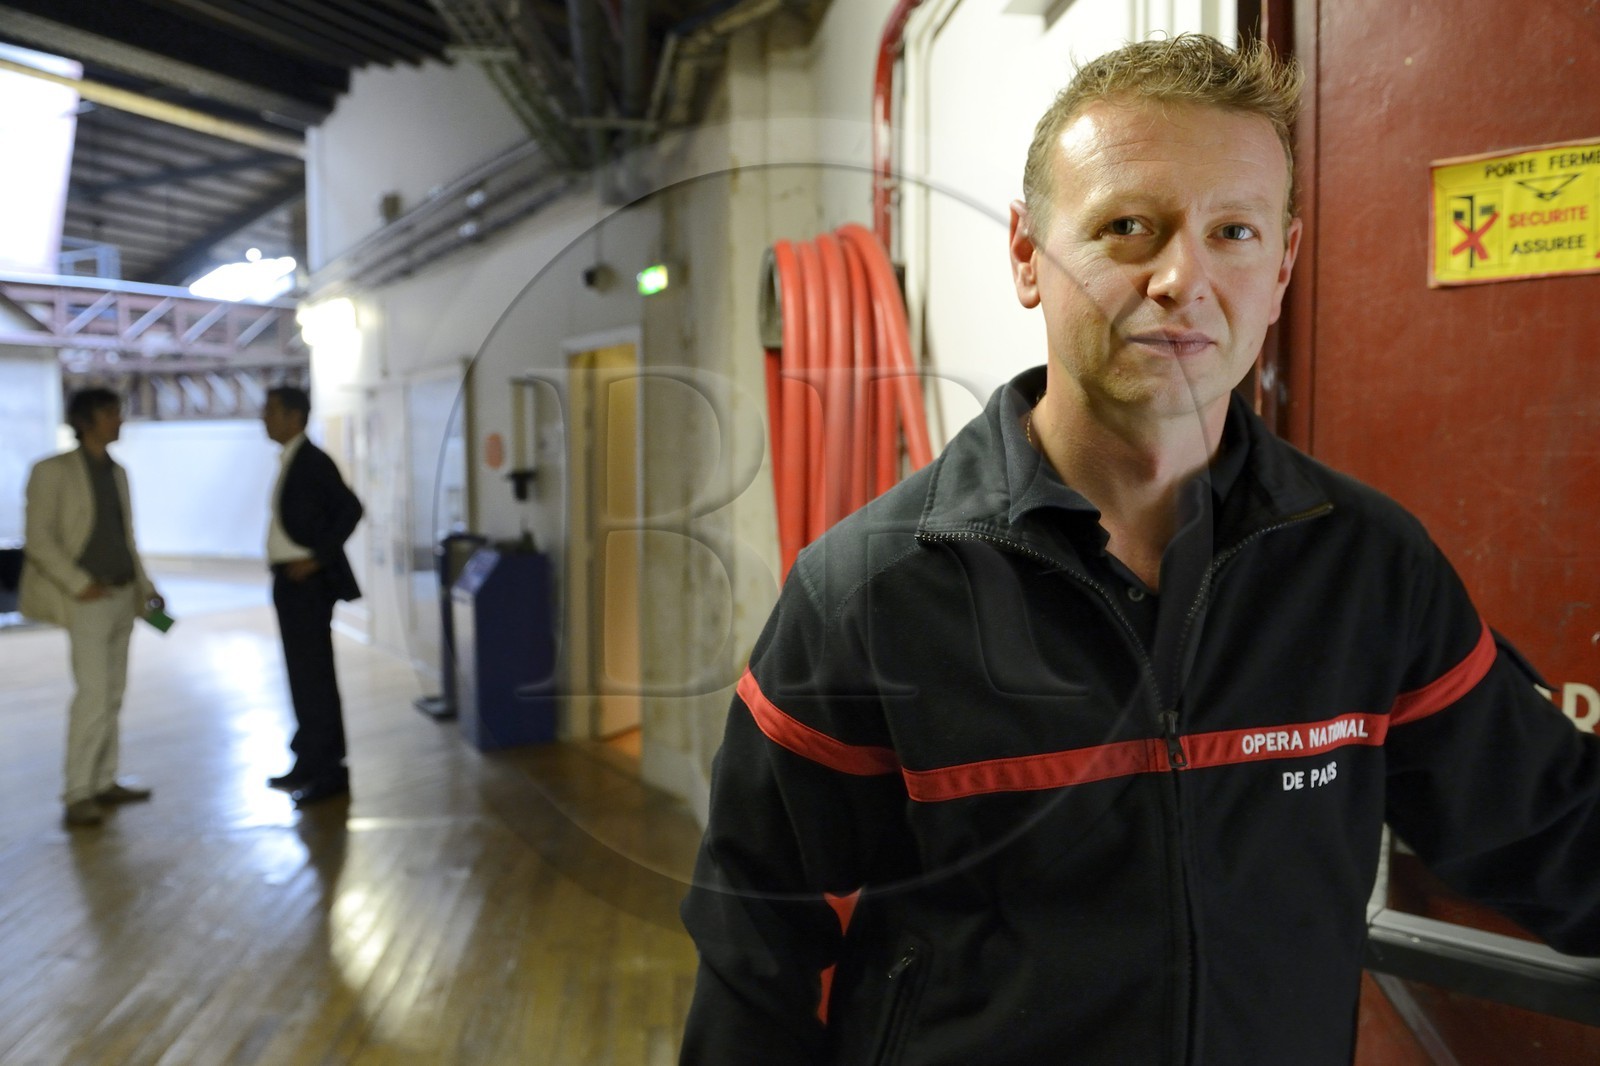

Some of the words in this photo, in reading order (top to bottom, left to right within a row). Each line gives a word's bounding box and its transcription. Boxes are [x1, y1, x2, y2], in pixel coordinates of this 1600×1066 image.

[1484, 159, 1537, 179] PORTE
[1507, 205, 1588, 229] SECURITE
[1510, 234, 1586, 255] ASSUREE
[1241, 730, 1304, 755] OPERA
[1282, 771, 1305, 791] DE
